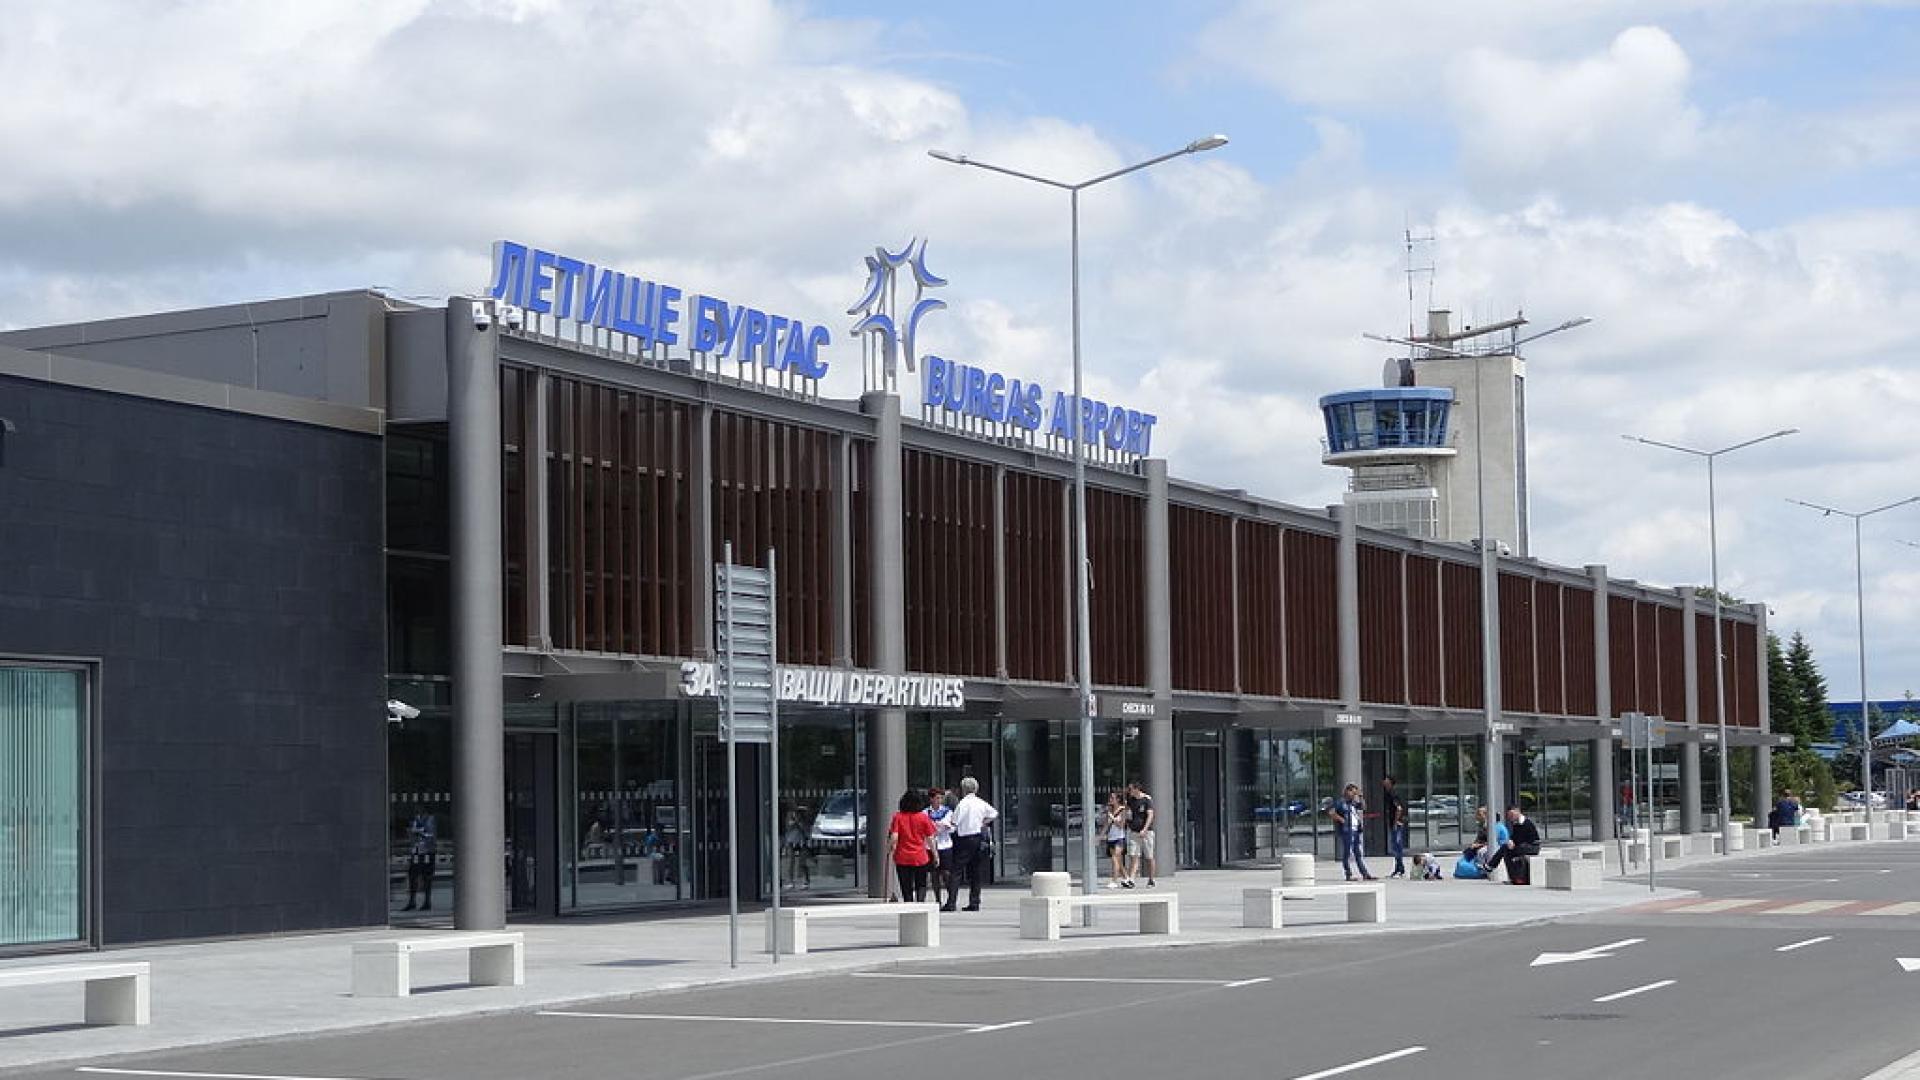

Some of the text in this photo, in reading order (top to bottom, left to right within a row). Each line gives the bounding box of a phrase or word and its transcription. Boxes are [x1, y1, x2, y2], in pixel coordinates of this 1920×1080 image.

[492, 240, 830, 379] ЛЕТИЩЕ БУРГАС
[921, 355, 1157, 457] BURGAS AIRPORT
[849, 673, 965, 708] DEPARTURES
